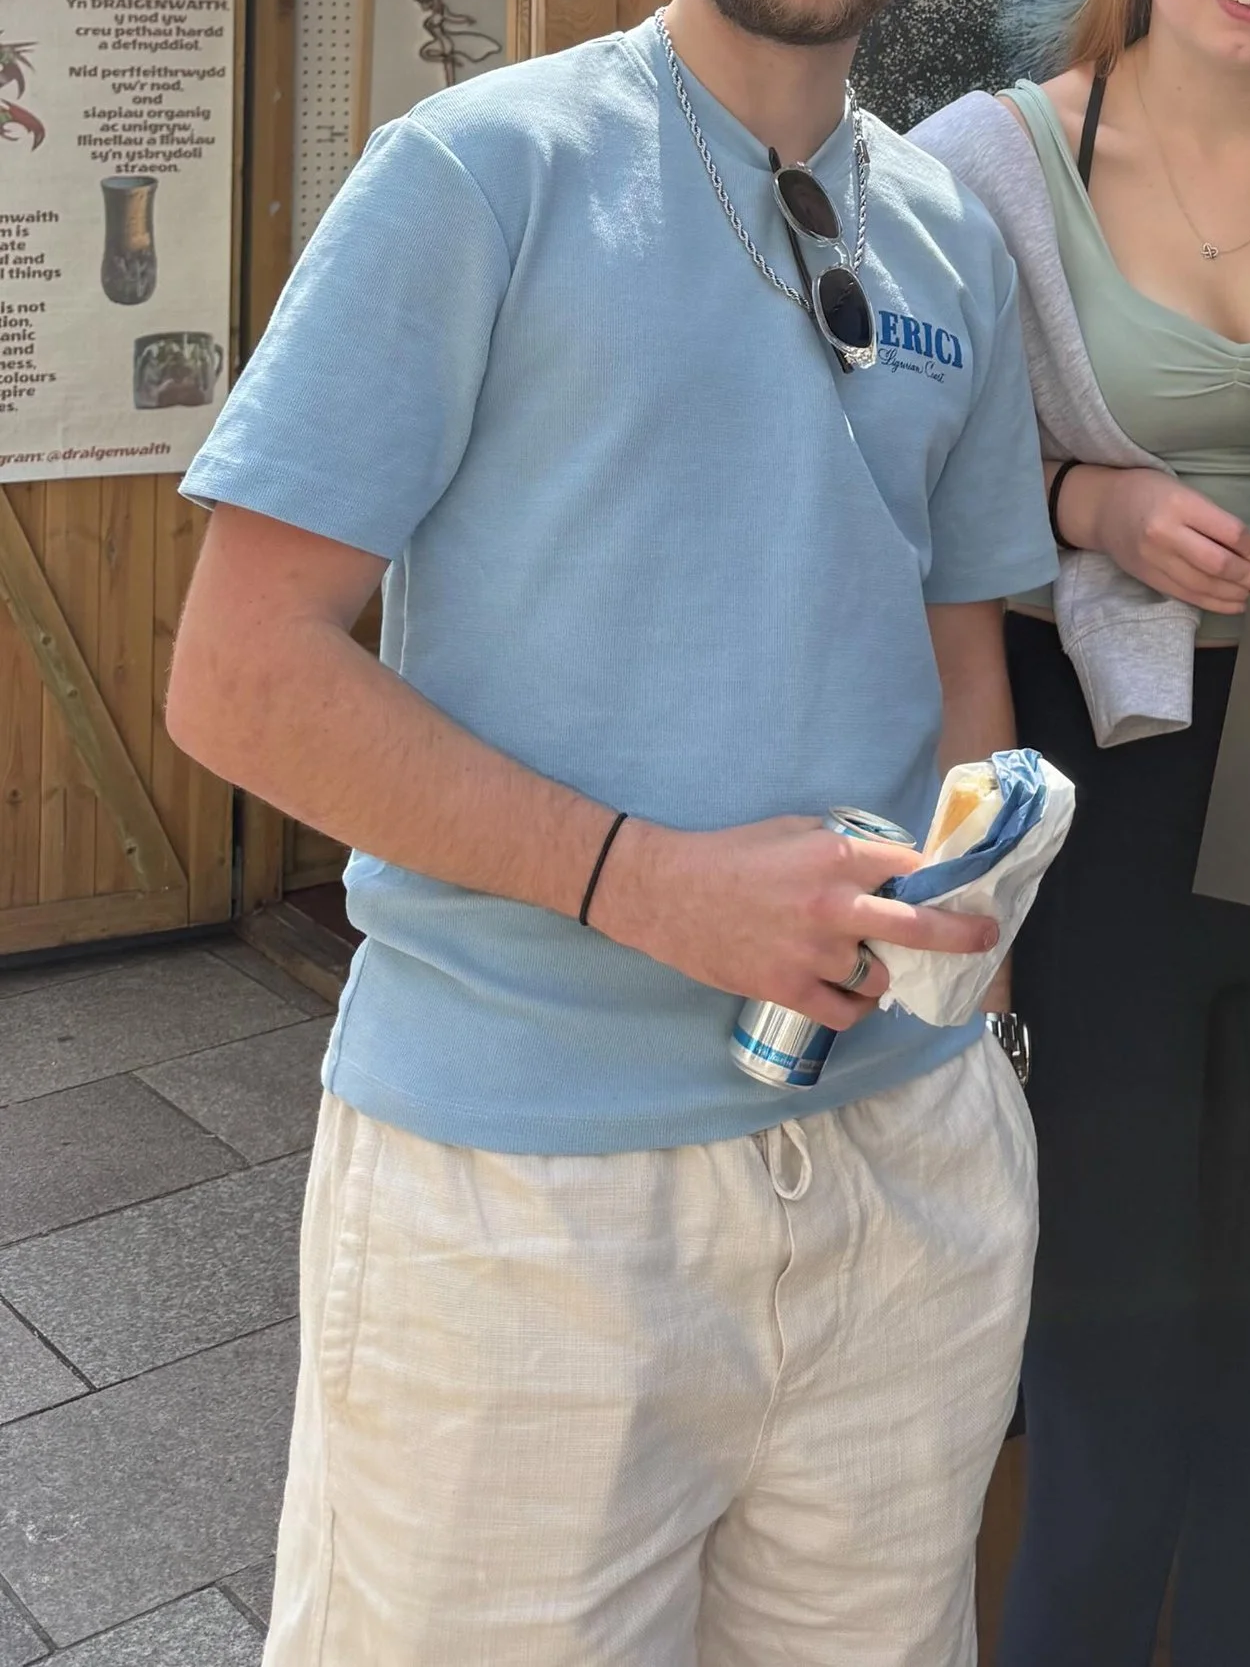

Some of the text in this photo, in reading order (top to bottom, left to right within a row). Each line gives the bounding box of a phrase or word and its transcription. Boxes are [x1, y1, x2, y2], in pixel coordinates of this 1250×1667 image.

[114, 12, 188, 26] y nod yw
[75, 26, 224, 39] creu pethau hardd
[98, 38, 202, 53] a defnyddiol.
[69, 65, 226, 80] Nid perffeithrwydd
[111, 81, 147, 94] yw'r
[132, 93, 163, 105] ond
[83, 106, 211, 120] siapiau organig
[99, 122, 119, 133] ac
[77, 134, 215, 147] llinellau a lliwiau
[90, 148, 202, 163] sy'n ysbrydoli
[16, 225, 30, 237] is
[12, 252, 45, 265] and
[8, 266, 62, 281] things
[1, 301, 46, 314] is not
[876, 310, 963, 369] ERICI
[3, 343, 34, 355] and
[47, 442, 171, 463] @draigenwaith
